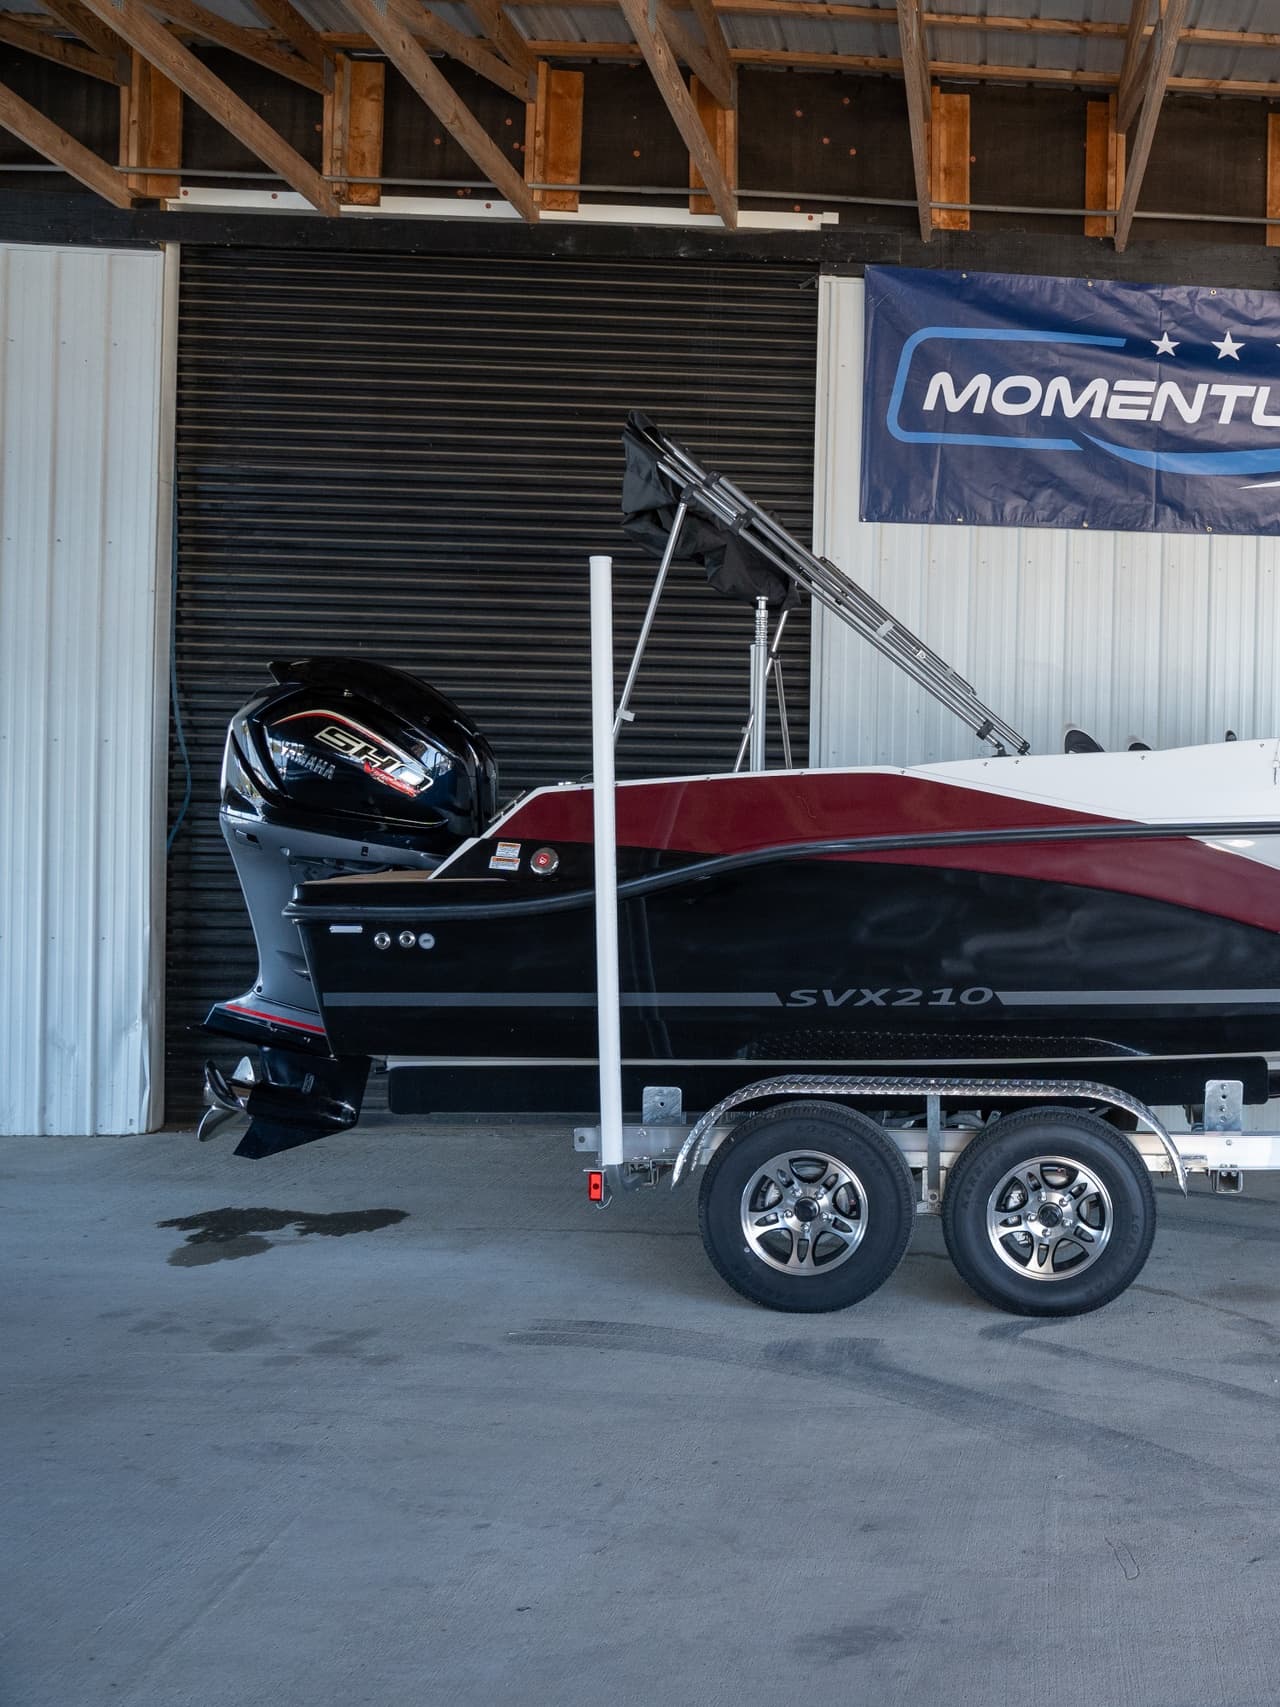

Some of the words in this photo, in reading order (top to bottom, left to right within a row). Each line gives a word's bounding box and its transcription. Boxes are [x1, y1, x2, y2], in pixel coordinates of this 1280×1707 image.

[281, 746, 336, 781] YAMAHA
[314, 726, 433, 791] SHO
[786, 987, 994, 1007] SVX210
